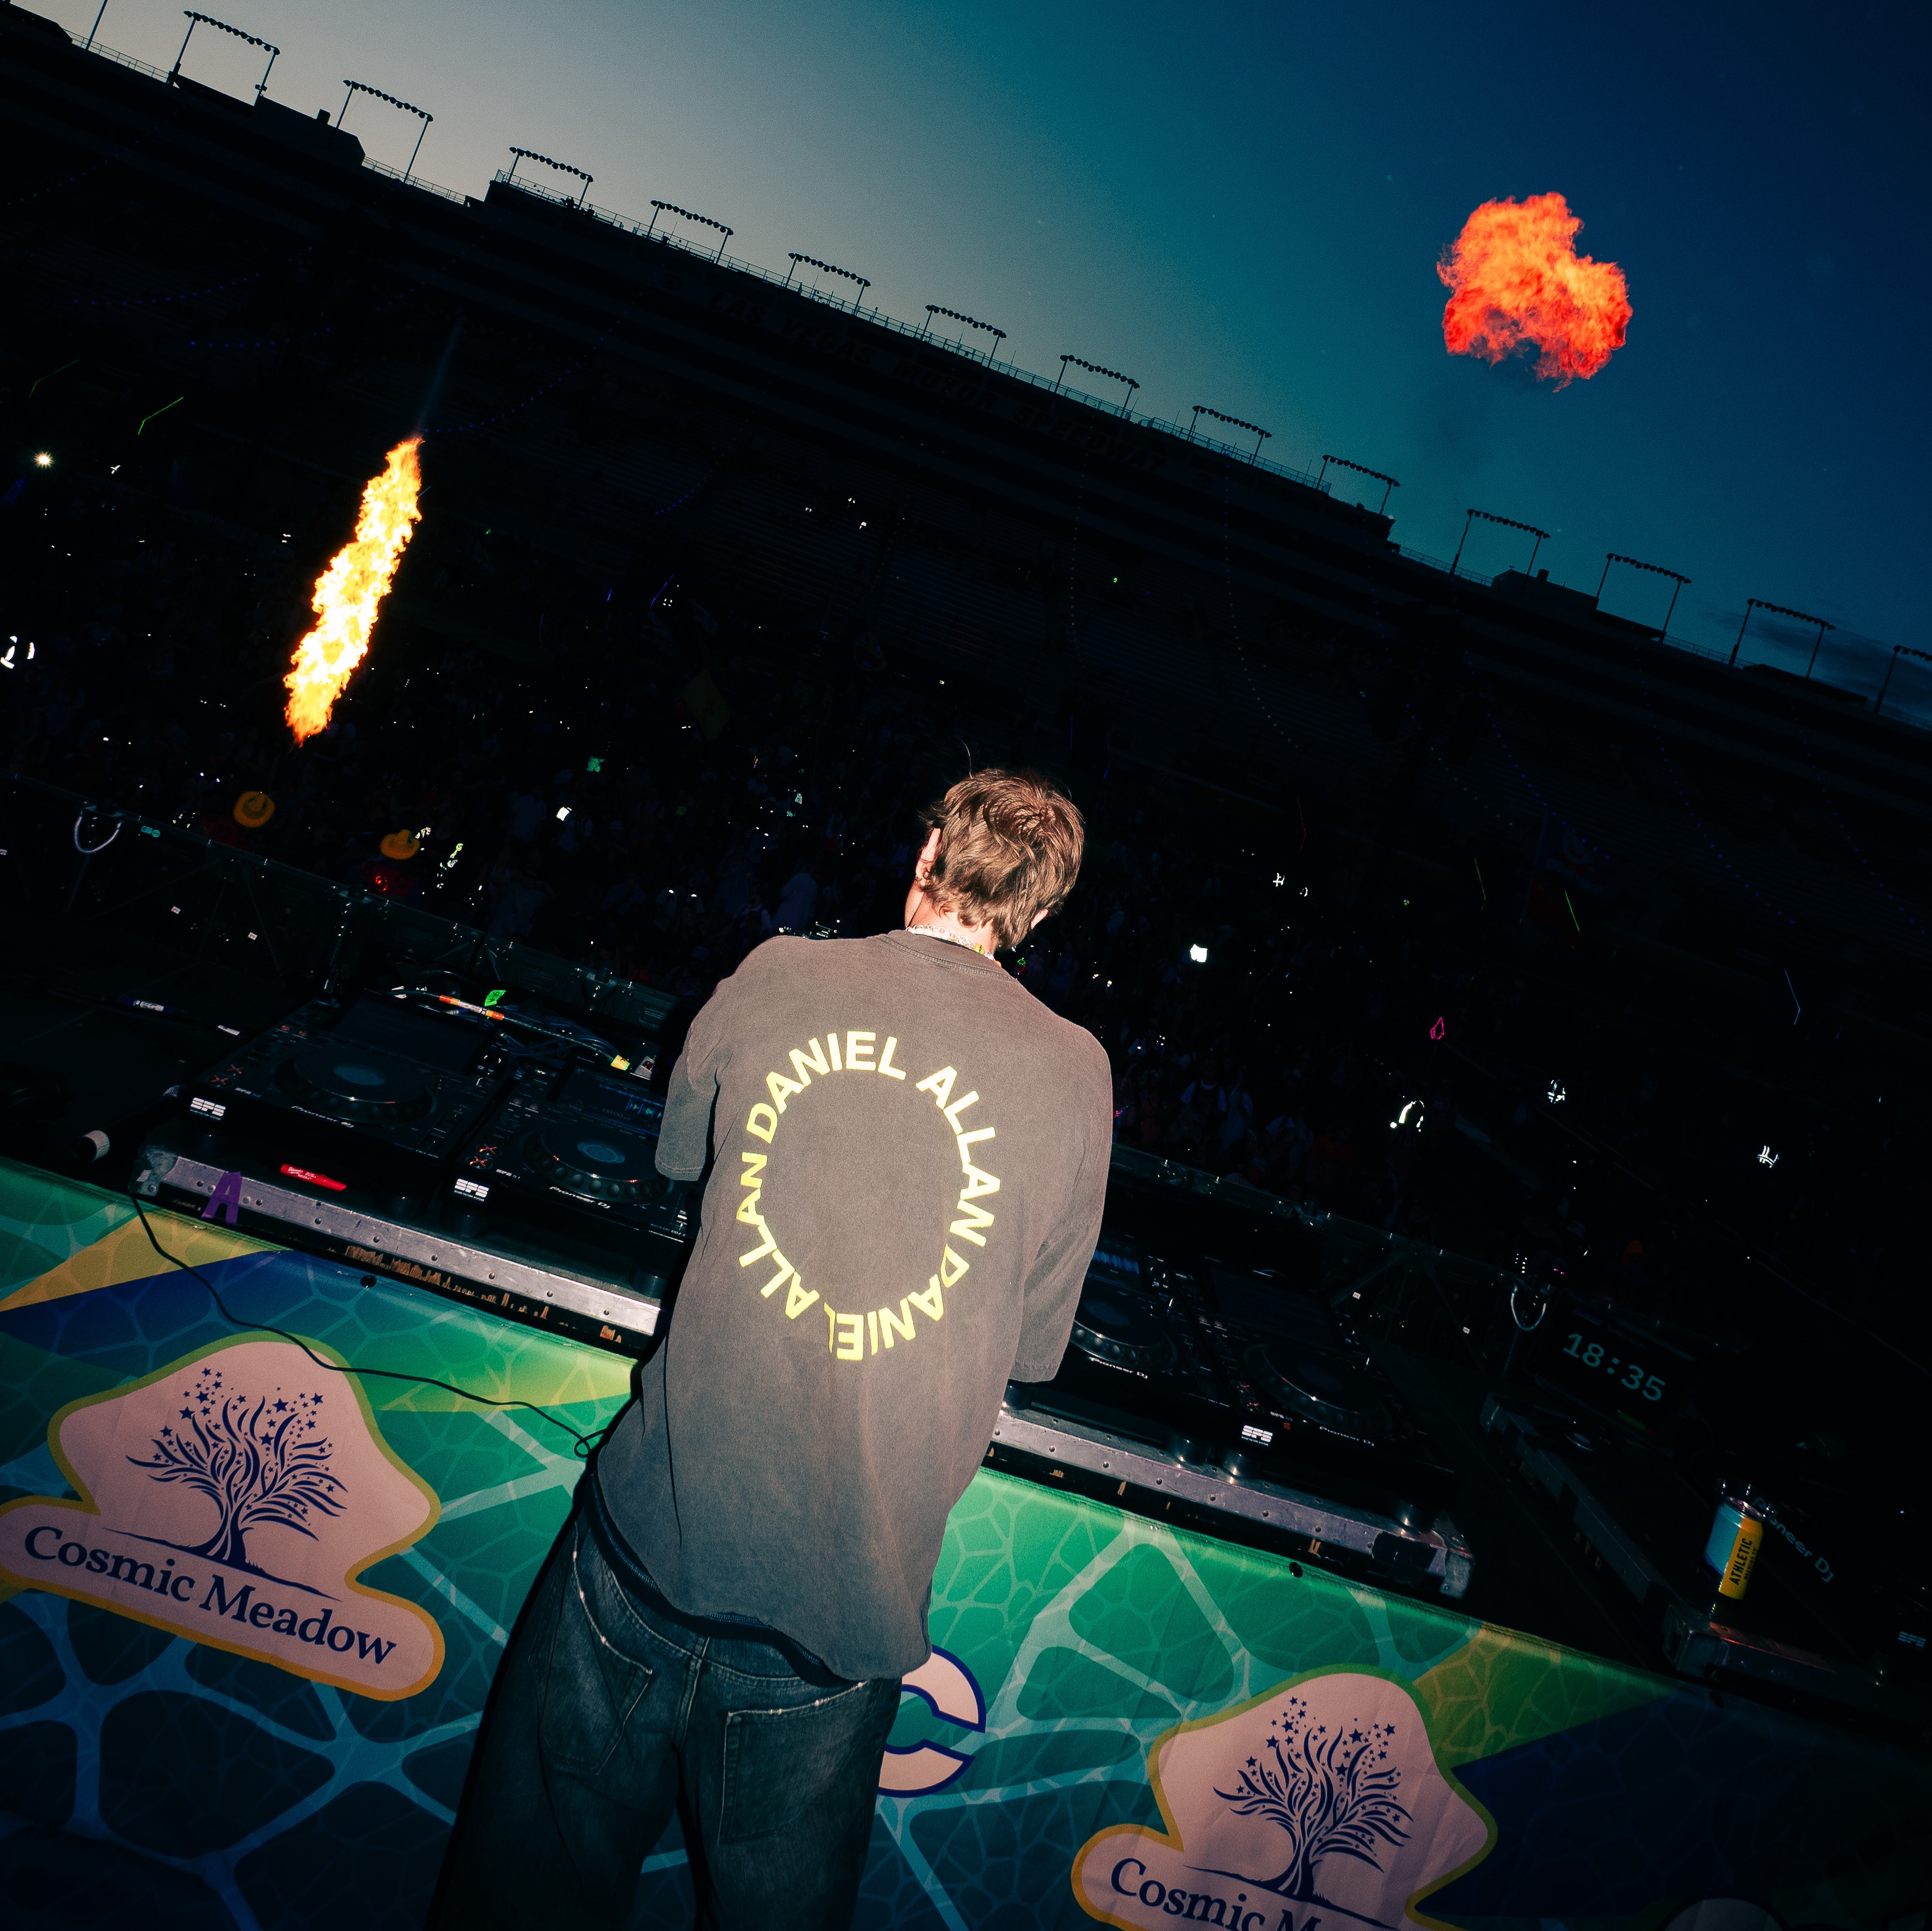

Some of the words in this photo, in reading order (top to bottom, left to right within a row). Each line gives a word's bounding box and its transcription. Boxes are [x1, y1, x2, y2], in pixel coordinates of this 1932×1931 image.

[707, 291, 767, 324] LAS
[781, 316, 877, 365] VEGAS
[891, 359, 997, 411] MOTOR
[1012, 404, 1168, 474] SPEEDWAY
[746, 1030, 907, 1144] DANIEL
[200, 1171, 242, 1225] A
[915, 1065, 1001, 1247] ALLAN
[736, 1151, 820, 1320] ALLAN
[824, 1243, 970, 1361] DANIEL
[1562, 1332, 1667, 1402] 18:35
[25, 1525, 195, 1601] Cosmic
[199, 1574, 396, 1665] Meadow
[1729, 1538, 1752, 1586] ATHLETIC
[1110, 1857, 1265, 1931] Cosmic
